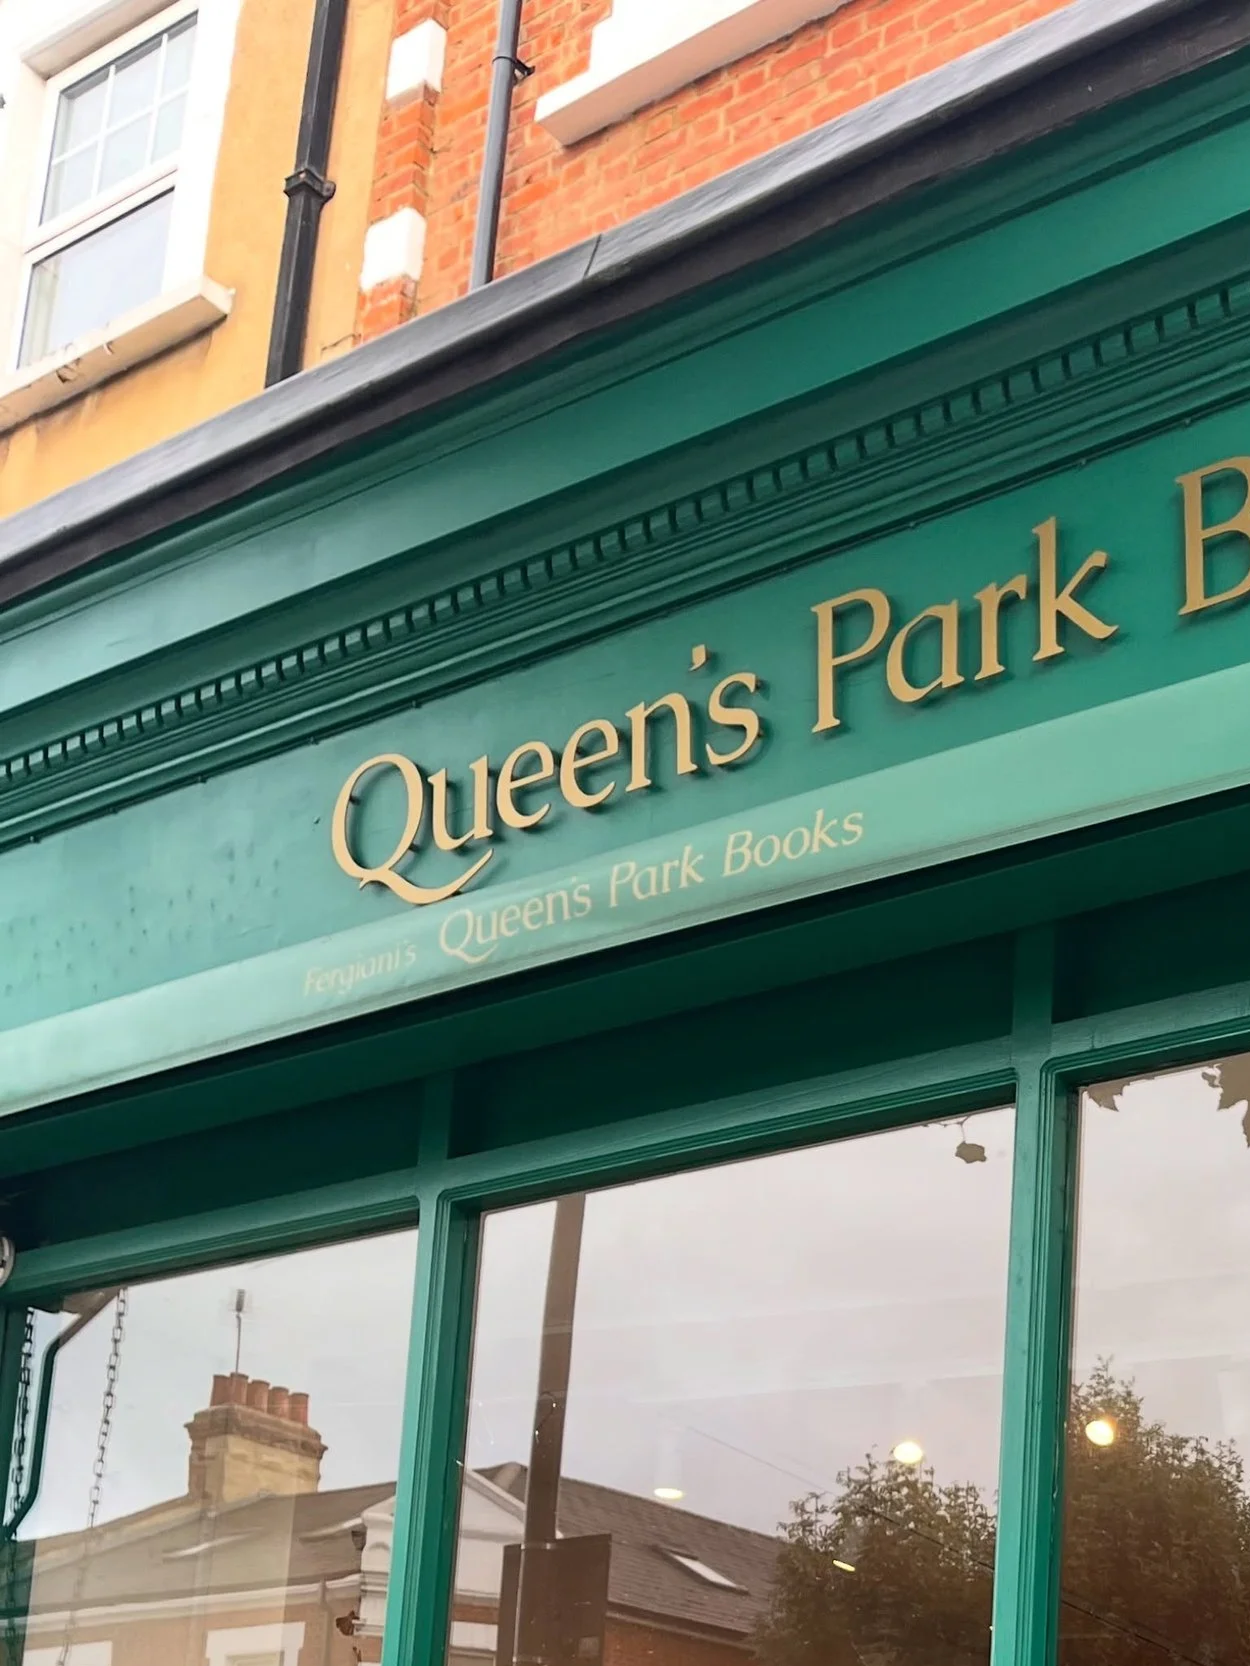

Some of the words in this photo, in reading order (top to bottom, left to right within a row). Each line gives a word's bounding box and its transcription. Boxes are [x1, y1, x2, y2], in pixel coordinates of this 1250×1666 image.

[331, 643, 764, 905] Queen's
[811, 515, 1120, 734] Park
[438, 875, 592, 965] Queen's
[608, 845, 705, 910] Park
[722, 811, 865, 877] Books
